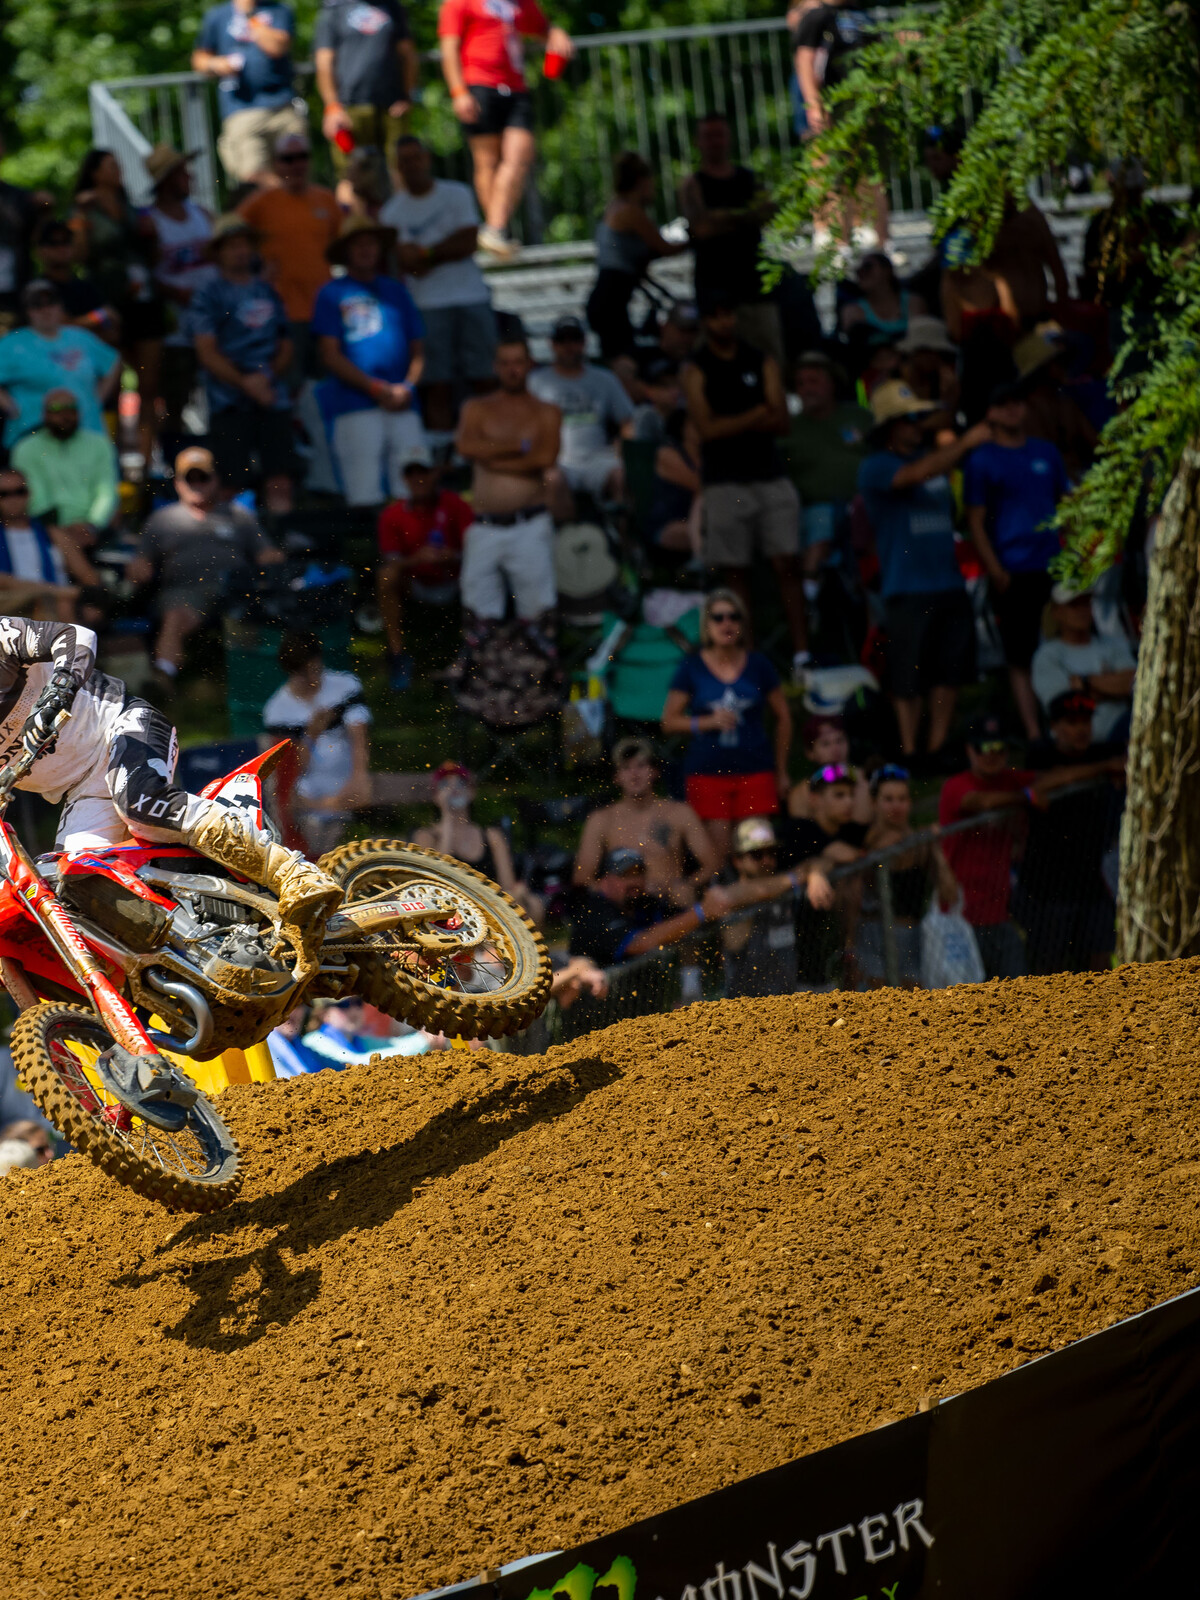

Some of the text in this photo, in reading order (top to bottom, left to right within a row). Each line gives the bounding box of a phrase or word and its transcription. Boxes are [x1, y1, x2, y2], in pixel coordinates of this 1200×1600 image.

[130, 793, 187, 823] FOX
[400, 901, 427, 911] DID
[101, 989, 148, 1048] DUNLOP
